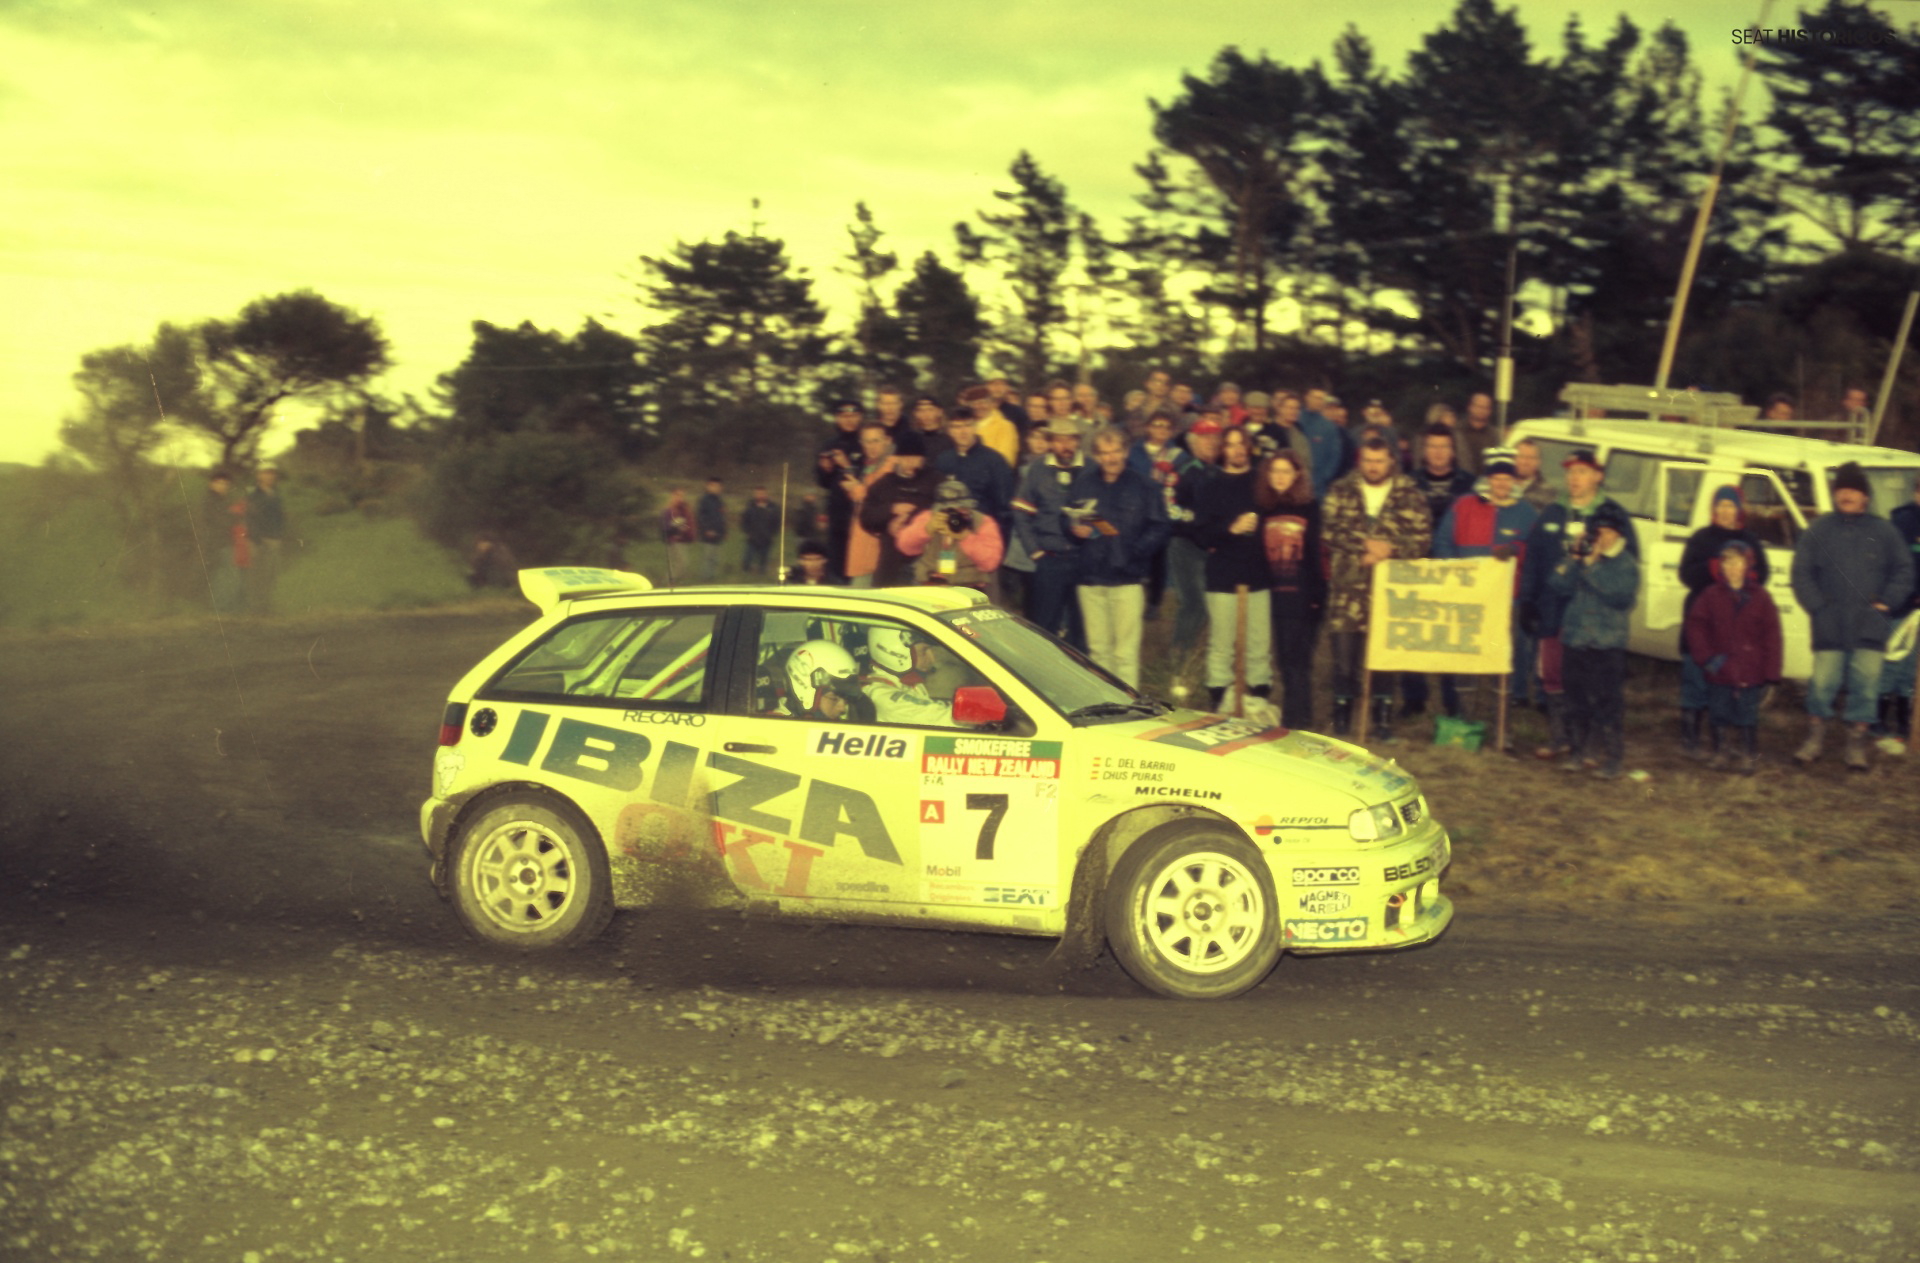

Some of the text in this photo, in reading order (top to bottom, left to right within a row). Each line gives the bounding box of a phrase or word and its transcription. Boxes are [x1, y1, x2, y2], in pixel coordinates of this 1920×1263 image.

[1385, 621, 1482, 655] RULE
[623, 709, 706, 728] RECARO
[816, 731, 907, 759] Hella
[953, 738, 1032, 758] SMOKEFREE
[926, 756, 1056, 778] RALLY NEW ZEALAND
[1118, 758, 1135, 769] DEL
[1140, 760, 1176, 772] BARRIO
[1102, 771, 1164, 782] CHUS PURAS
[499, 709, 904, 866] IBIZA
[1135, 786, 1222, 800] MICHELIN
[924, 804, 940, 820] A
[1280, 816, 1329, 824] REPSOL
[966, 793, 1009, 860] 7
[926, 865, 962, 877] Mobil
[1293, 868, 1359, 885] sparco
[1288, 920, 1367, 940] NECTO
